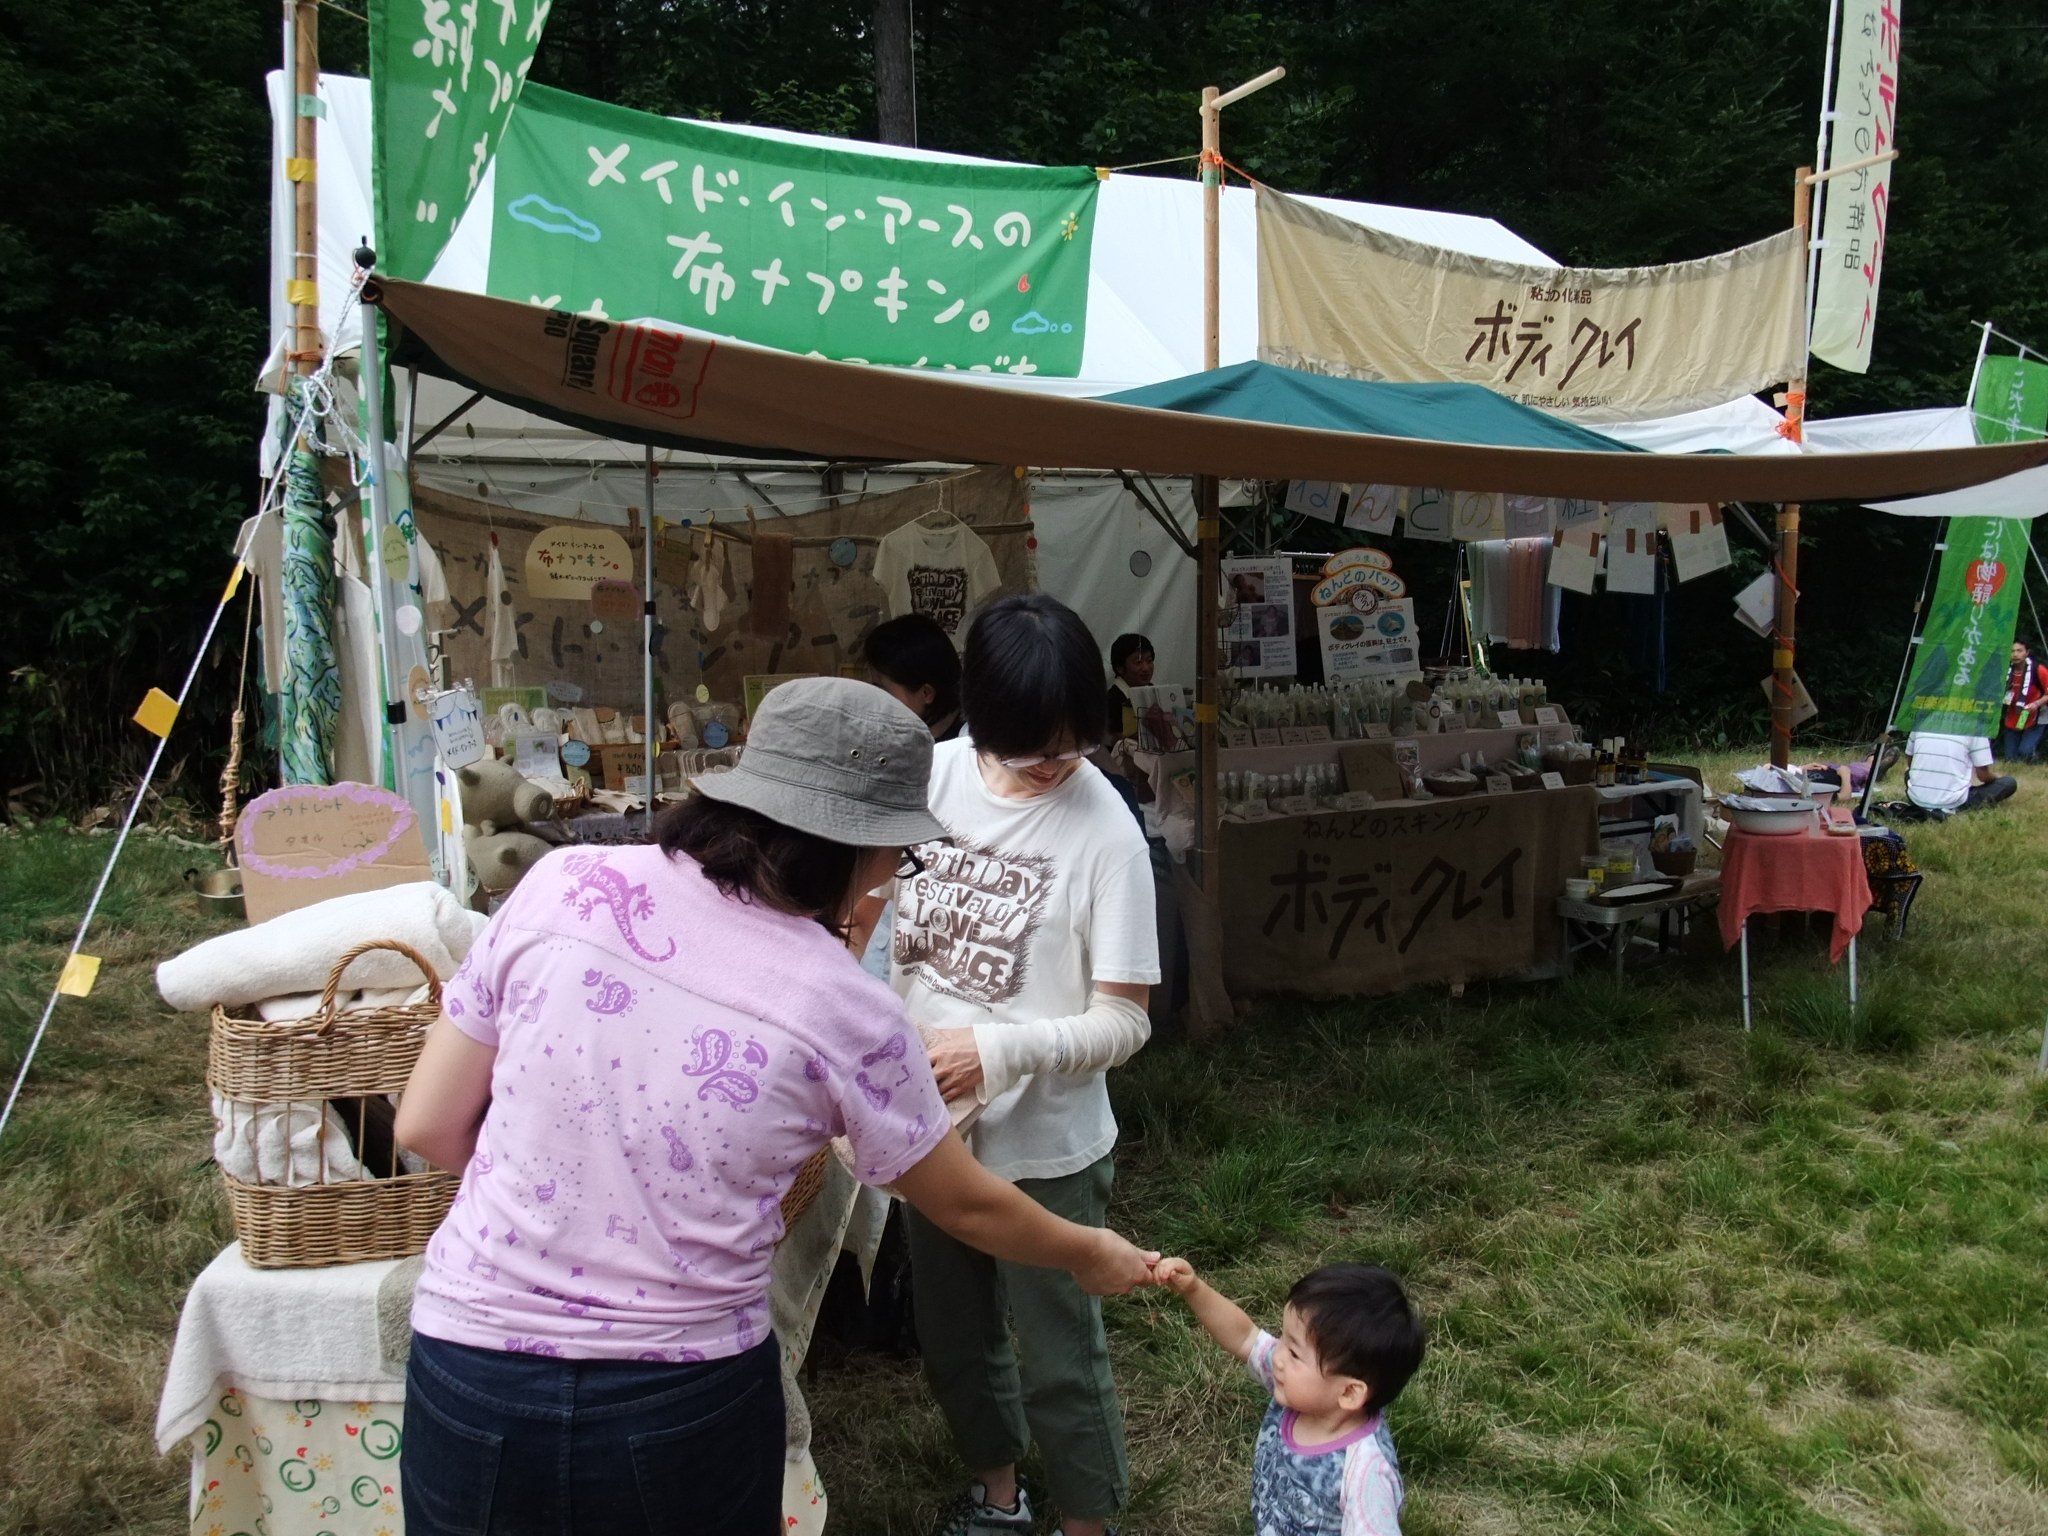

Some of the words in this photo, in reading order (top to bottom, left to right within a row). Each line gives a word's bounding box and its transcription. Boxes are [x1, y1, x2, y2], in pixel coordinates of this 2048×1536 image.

[666, 231, 990, 333] 布ナプキン。
[1530, 286, 1592, 304] 粘土の化粧品
[261, 800, 344, 821] アウトレット
[1302, 804, 1491, 841] ねんどのスキンケア
[285, 834, 324, 848] タオル
[978, 858, 1045, 906] Day
[913, 898, 983, 942] LOVE
[1262, 846, 1523, 960] ボディクレイ
